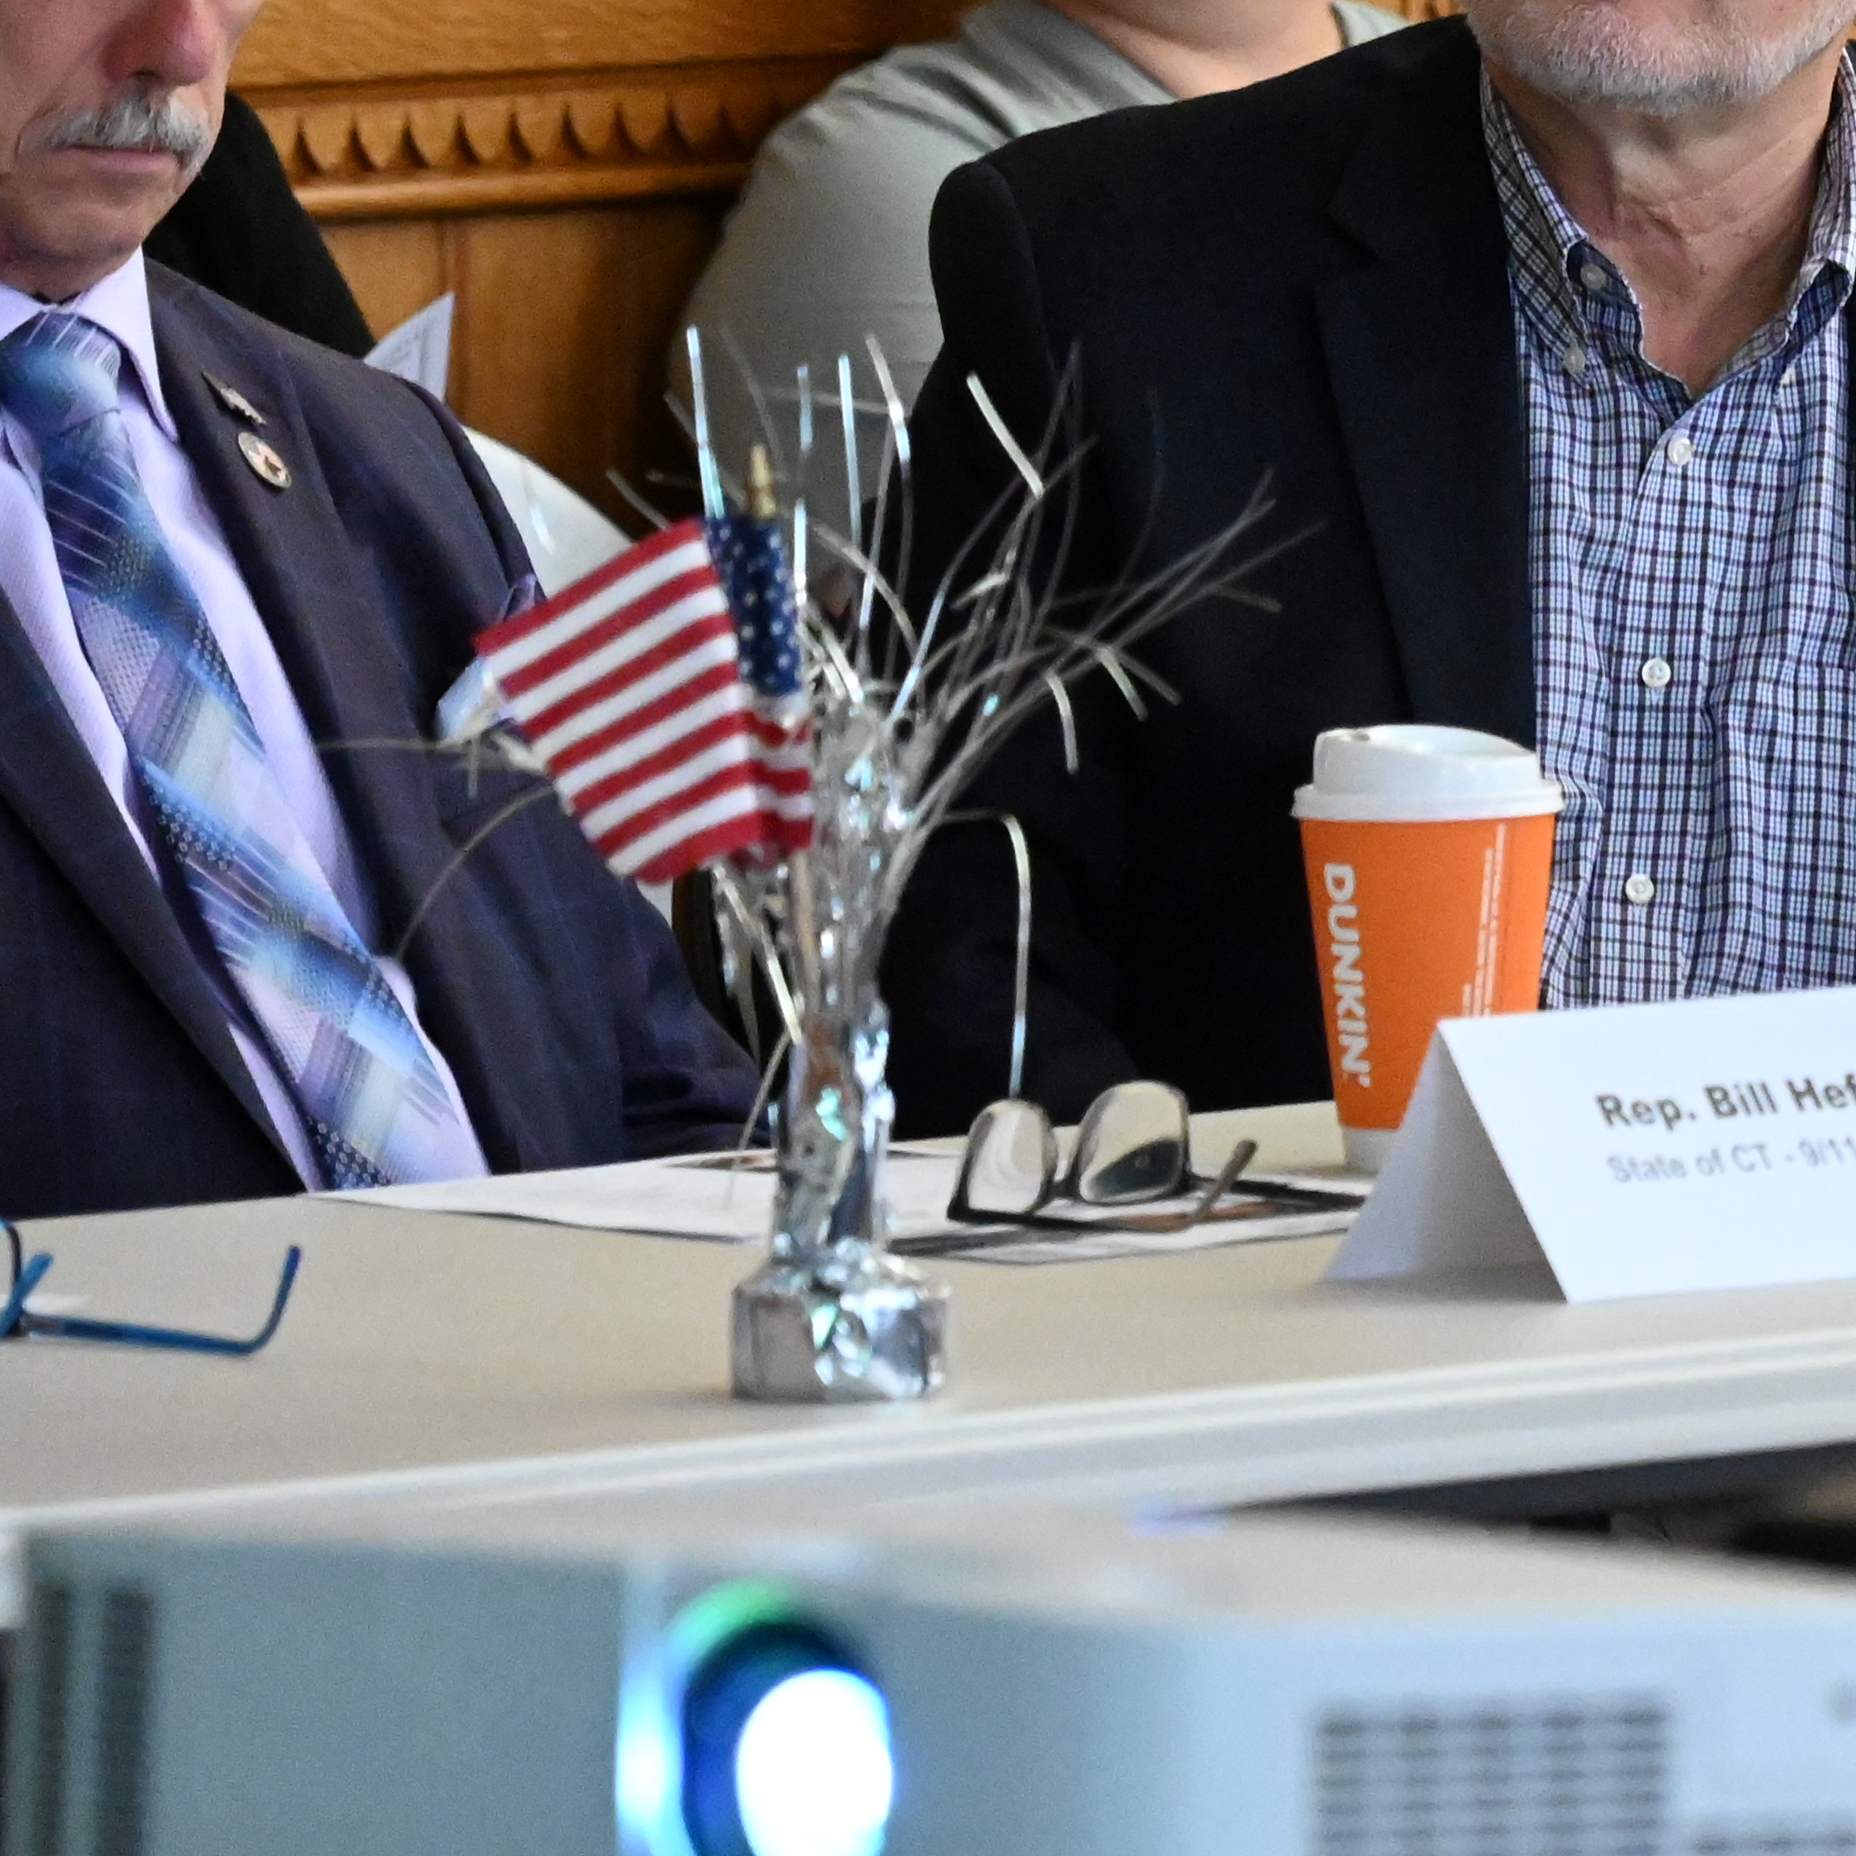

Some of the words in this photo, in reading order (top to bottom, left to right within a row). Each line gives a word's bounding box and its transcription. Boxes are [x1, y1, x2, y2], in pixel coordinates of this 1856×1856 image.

[1323, 863, 1371, 1087] DUNKIN'
[1594, 1092, 1698, 1132] Rep.
[1704, 1081, 1779, 1120] Bill
[1606, 1152, 1689, 1185] State
[1694, 1147, 1725, 1177] of
[1729, 1142, 1774, 1174] CT
